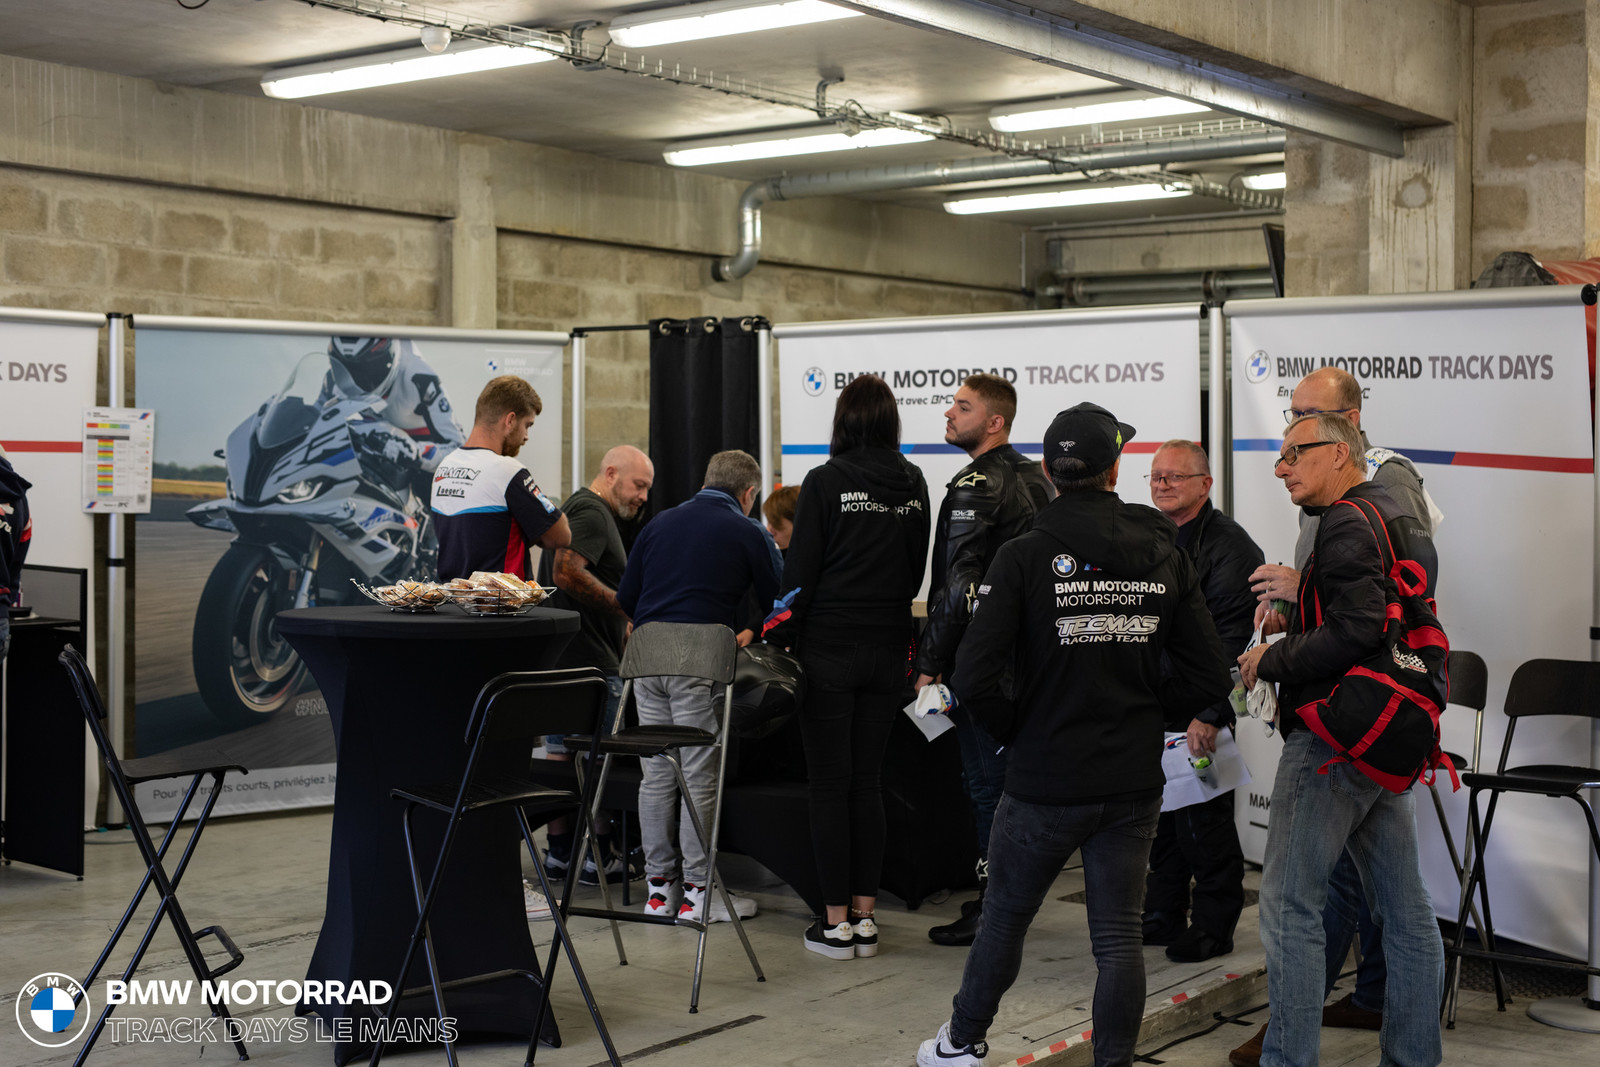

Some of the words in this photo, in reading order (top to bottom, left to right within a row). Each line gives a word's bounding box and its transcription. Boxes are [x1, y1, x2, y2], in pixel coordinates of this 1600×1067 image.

[8, 361, 68, 383] DAYS
[1025, 364, 1100, 385] TRACK
[1105, 362, 1165, 383] DAYS
[1276, 356, 1315, 378] BMW
[1428, 355, 1494, 379] TRACK
[1499, 354, 1553, 380] DAYS
[905, 397, 928, 405] avec
[840, 491, 868, 502] BMW
[841, 501, 911, 515] MOTORSRT
[1055, 581, 1089, 594] BMW
[1093, 580, 1166, 594] MOTORRAD
[1056, 594, 1145, 608] MOTORSPORT
[1056, 613, 1160, 638] TECMAS
[1060, 634, 1113, 645] RACING
[1116, 635, 1149, 643] TEAM
[153, 789, 178, 799] Pour
[236, 780, 271, 792] courts,
[274, 775, 326, 791] privilégiez
